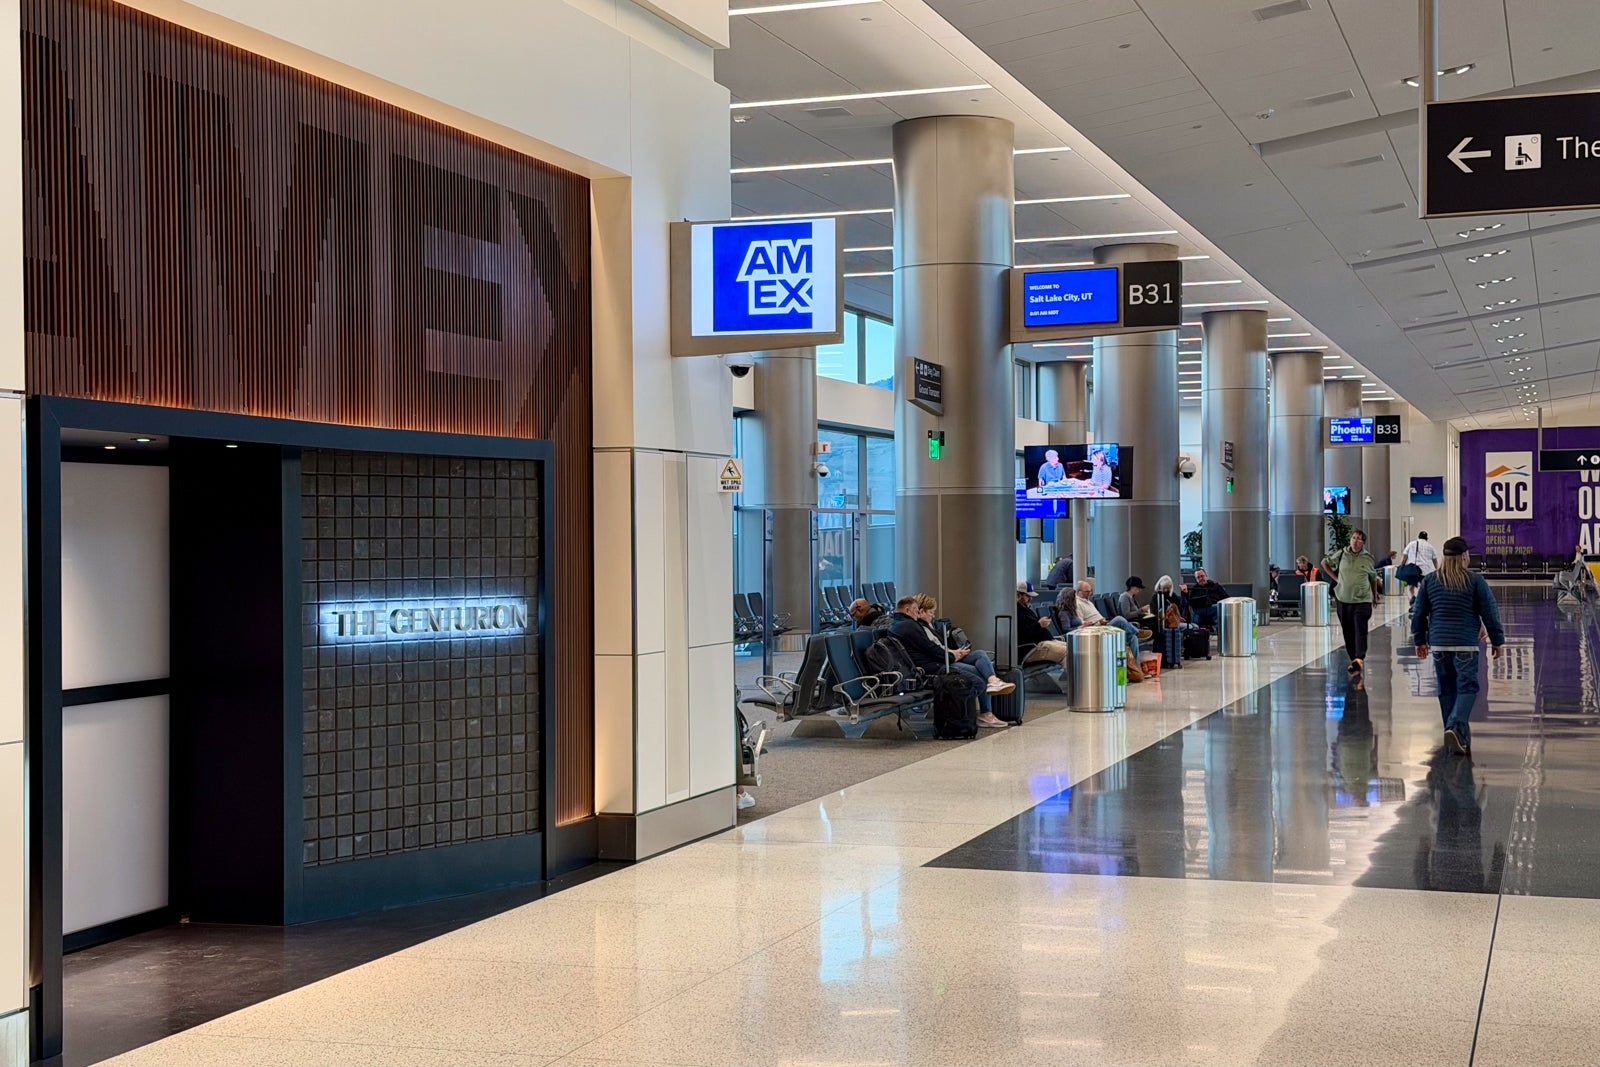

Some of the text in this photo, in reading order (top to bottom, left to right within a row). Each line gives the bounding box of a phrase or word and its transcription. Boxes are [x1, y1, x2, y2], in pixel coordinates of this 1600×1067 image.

[1556, 137, 1600, 160] The
[1029, 293, 1093, 303] Salt Lake City, UT
[1129, 283, 1174, 305] B31
[1331, 424, 1371, 434] Phoenix
[1377, 424, 1398, 434] B33
[1490, 481, 1528, 512] SLC
[1486, 524, 1511, 534] PHASE 4
[1486, 535, 1514, 545] OPENS IN
[1486, 546, 1513, 555] OCTOBER
[335, 604, 528, 637] THE CENTURION
